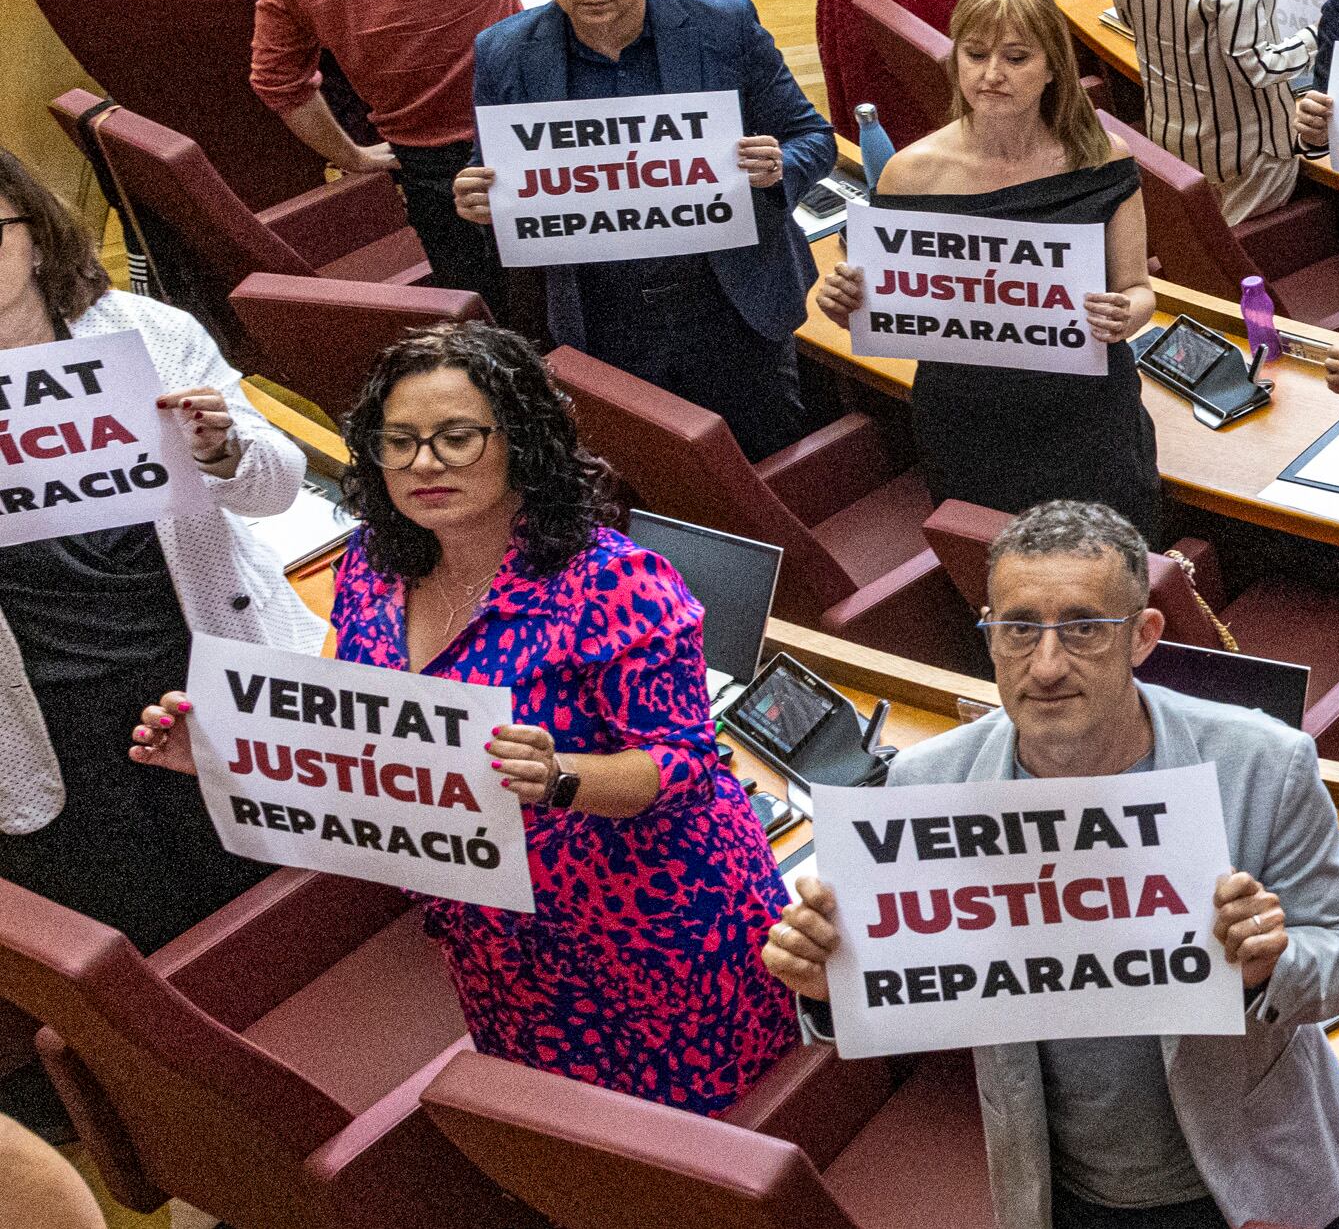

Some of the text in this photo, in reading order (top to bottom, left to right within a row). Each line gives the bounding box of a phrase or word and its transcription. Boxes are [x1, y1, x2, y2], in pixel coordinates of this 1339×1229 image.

[511, 112, 708, 150] VERITAT
[519, 151, 718, 197] JUSTÍCIA
[515, 193, 733, 240] REPARACIÓ
[875, 227, 1071, 268] VERITAT
[875, 269, 1074, 310] JUSTÍCIA
[869, 311, 1086, 349] REPARACIÓ
[226, 670, 468, 747] VERITAT
[228, 738, 482, 812] JUSTÍCIA
[229, 795, 501, 870] REPARACIÓ
[853, 803, 1166, 863] VERITAT
[868, 864, 1187, 938] JUSTÍCIA
[864, 931, 1211, 1008] REPARACIÓ
